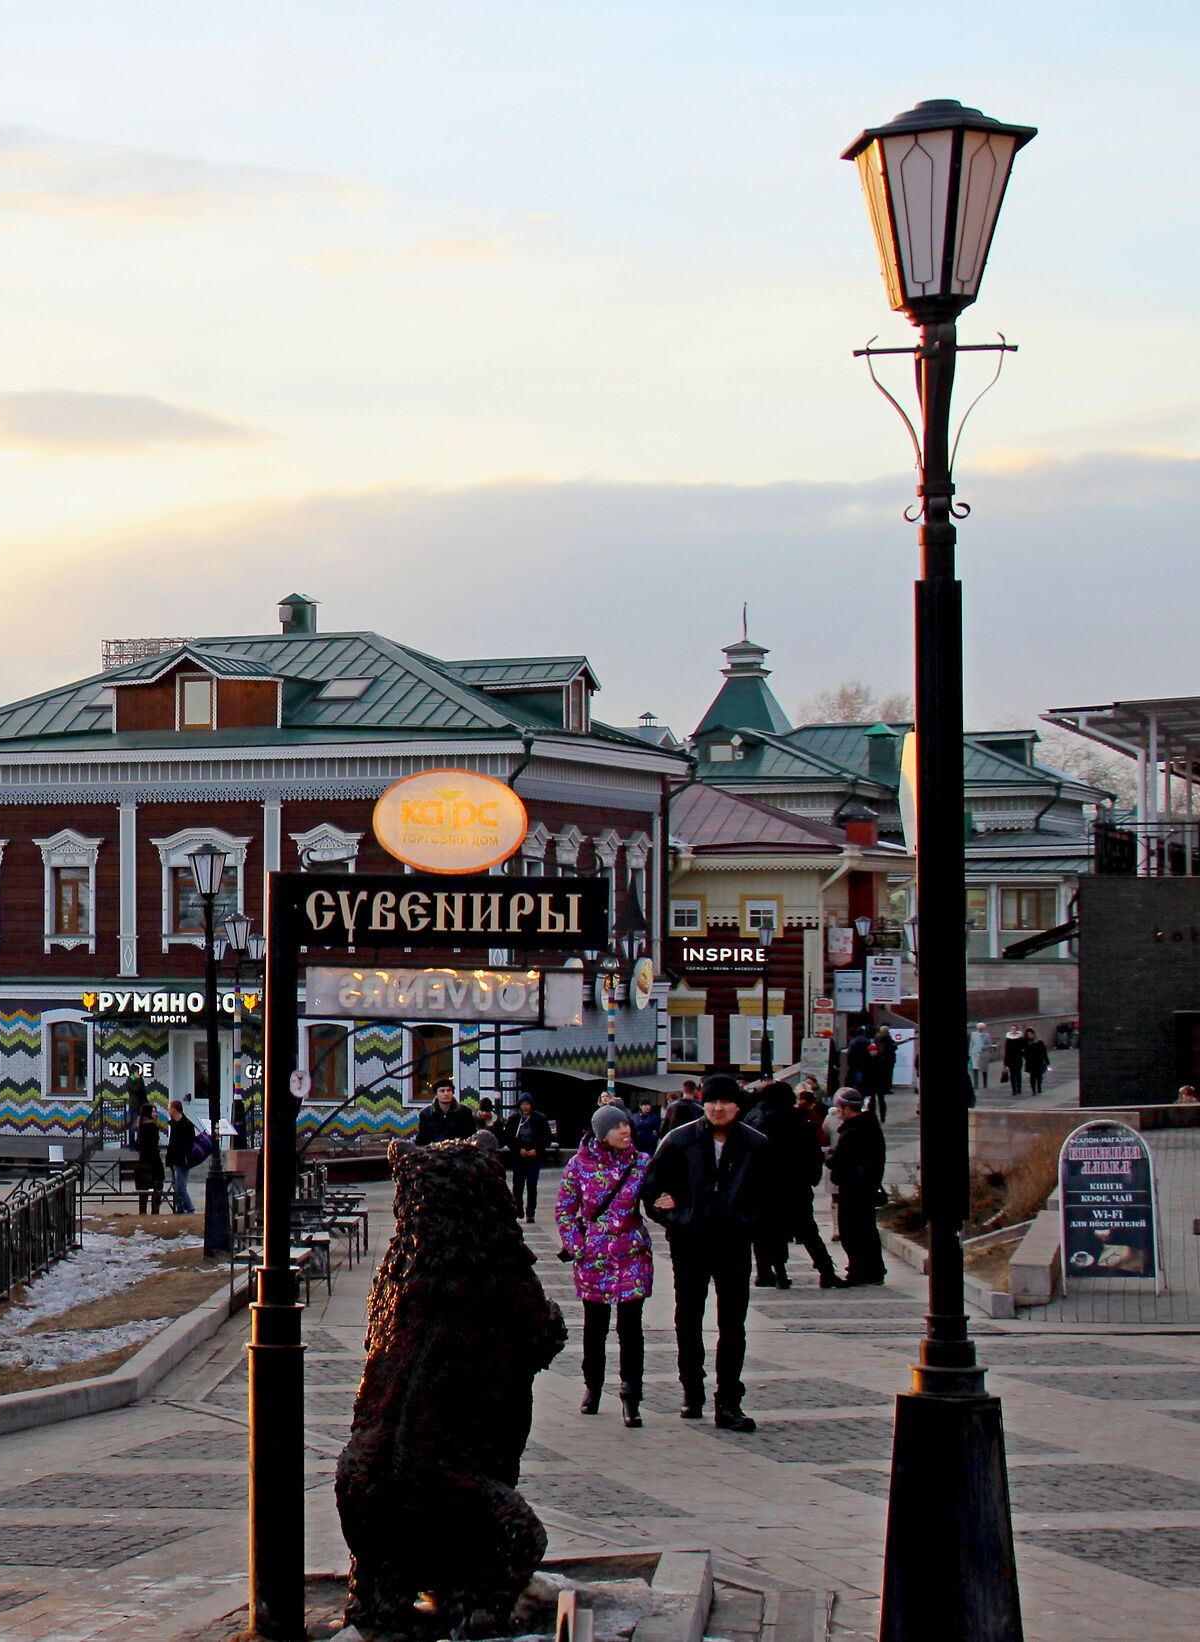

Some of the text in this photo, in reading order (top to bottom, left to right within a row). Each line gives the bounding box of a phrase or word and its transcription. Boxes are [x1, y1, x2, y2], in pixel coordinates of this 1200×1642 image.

[472, 834, 499, 847] ДОМ
[305, 890, 582, 942] СУВЕНИРЫ
[150, 1015, 187, 1023] ПИРОГИ
[1089, 1182, 1123, 1190] КНИГИ
[1112, 1193, 1133, 1202] ЧАЙ
[1092, 1209, 1123, 1219] Wi-Fi
[1089, 1219, 1146, 1228] посетителей
